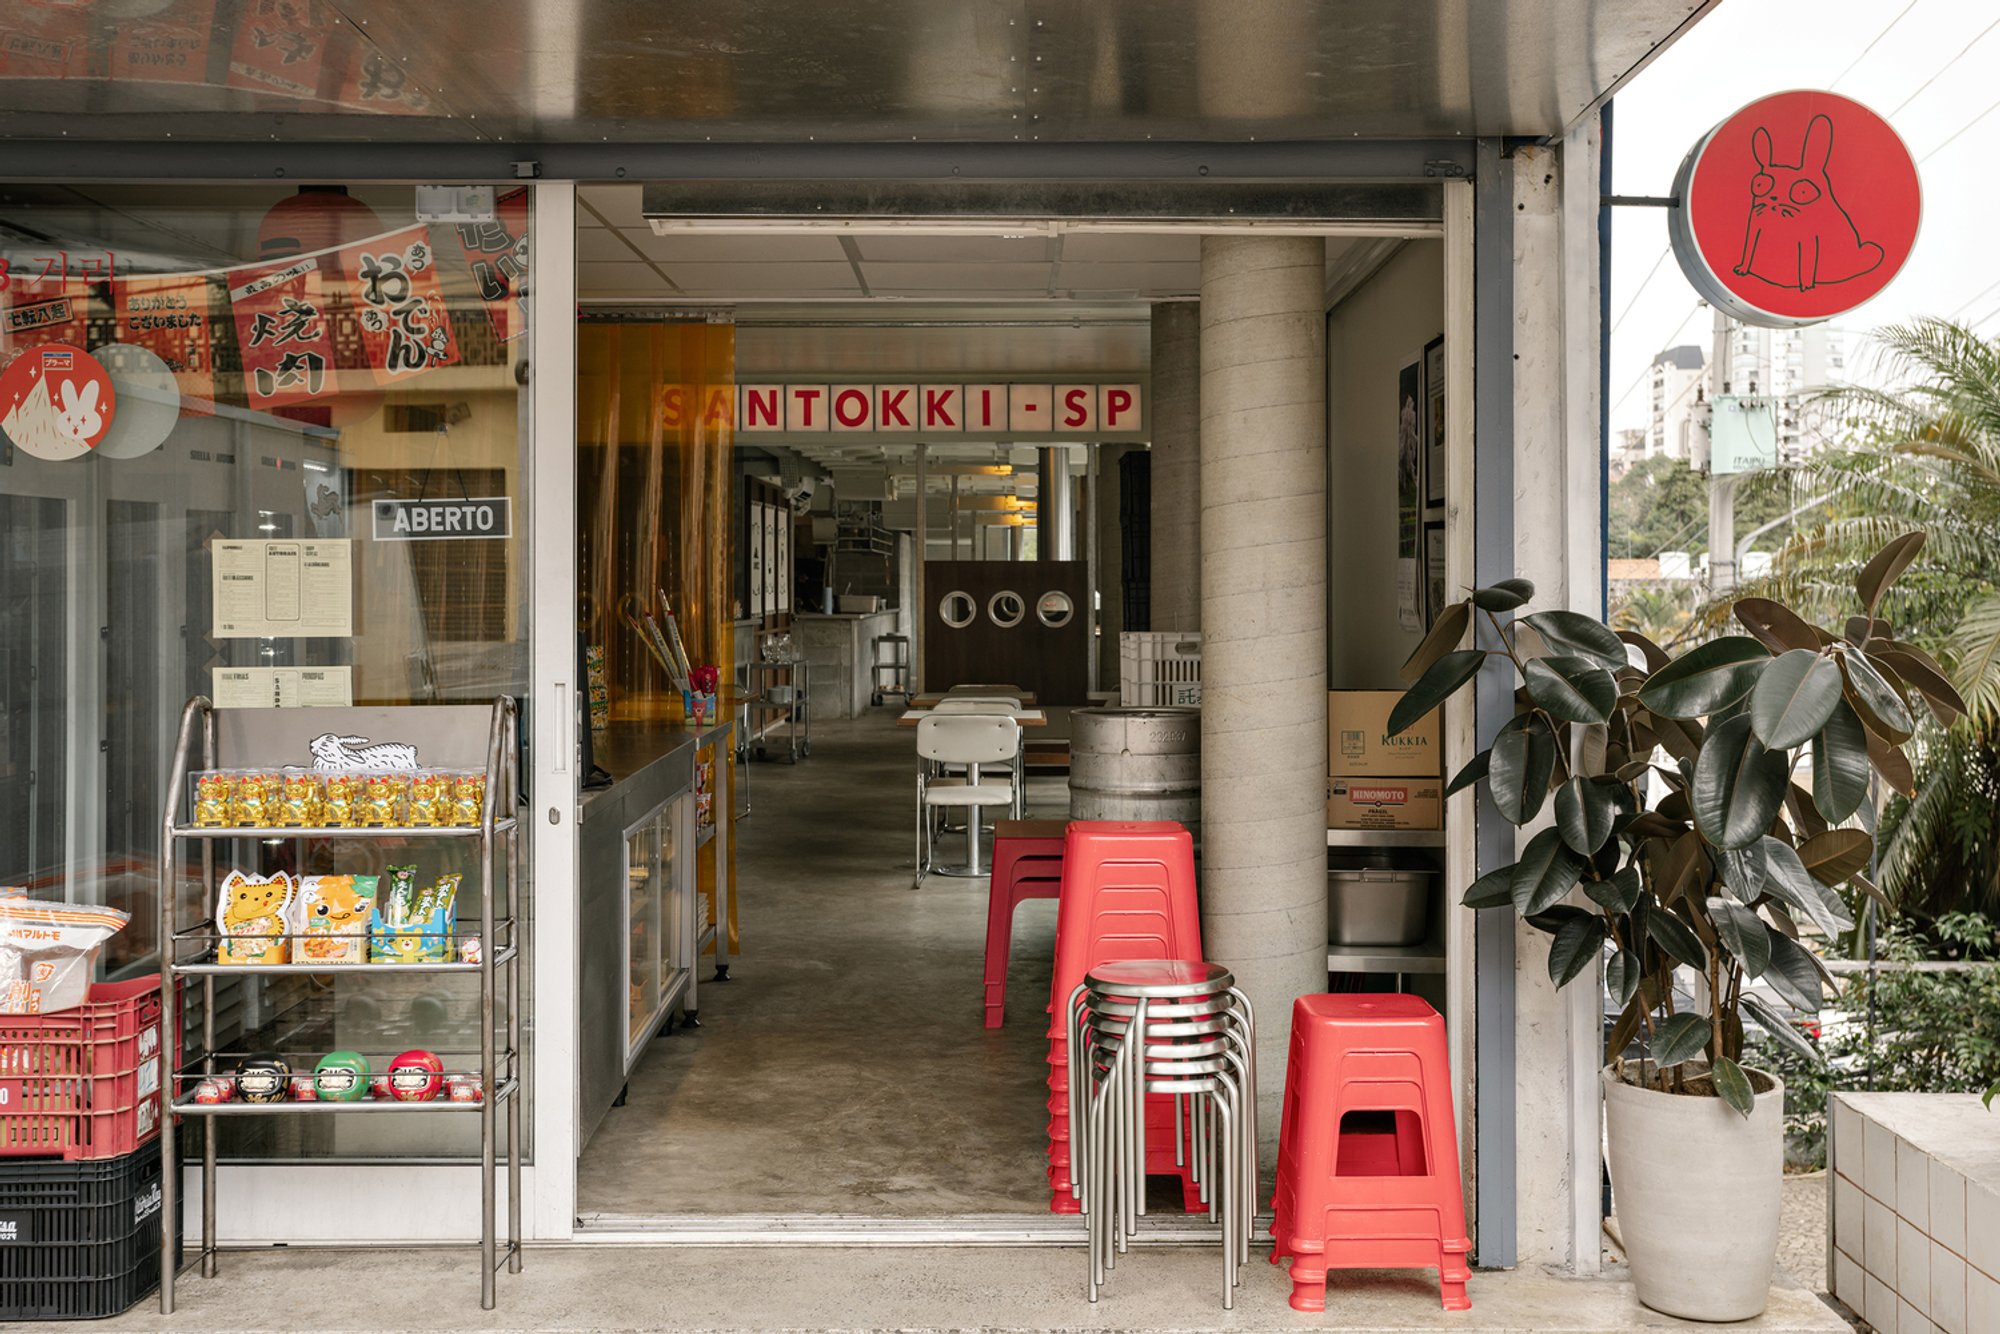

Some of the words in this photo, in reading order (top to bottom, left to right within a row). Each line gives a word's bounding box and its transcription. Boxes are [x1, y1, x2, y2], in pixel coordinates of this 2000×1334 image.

[128, 295, 188, 311] ありがとう
[8, 303, 67, 327] 七転八起
[129, 313, 202, 330] ございました
[359, 253, 428, 375] おでん
[249, 298, 325, 397] 焼肉
[393, 506, 494, 532] ABERTO
[1381, 734, 1428, 746] KUKKIA
[1352, 790, 1405, 800] HINOMOTO
[24, 929, 60, 941] マルトモ
